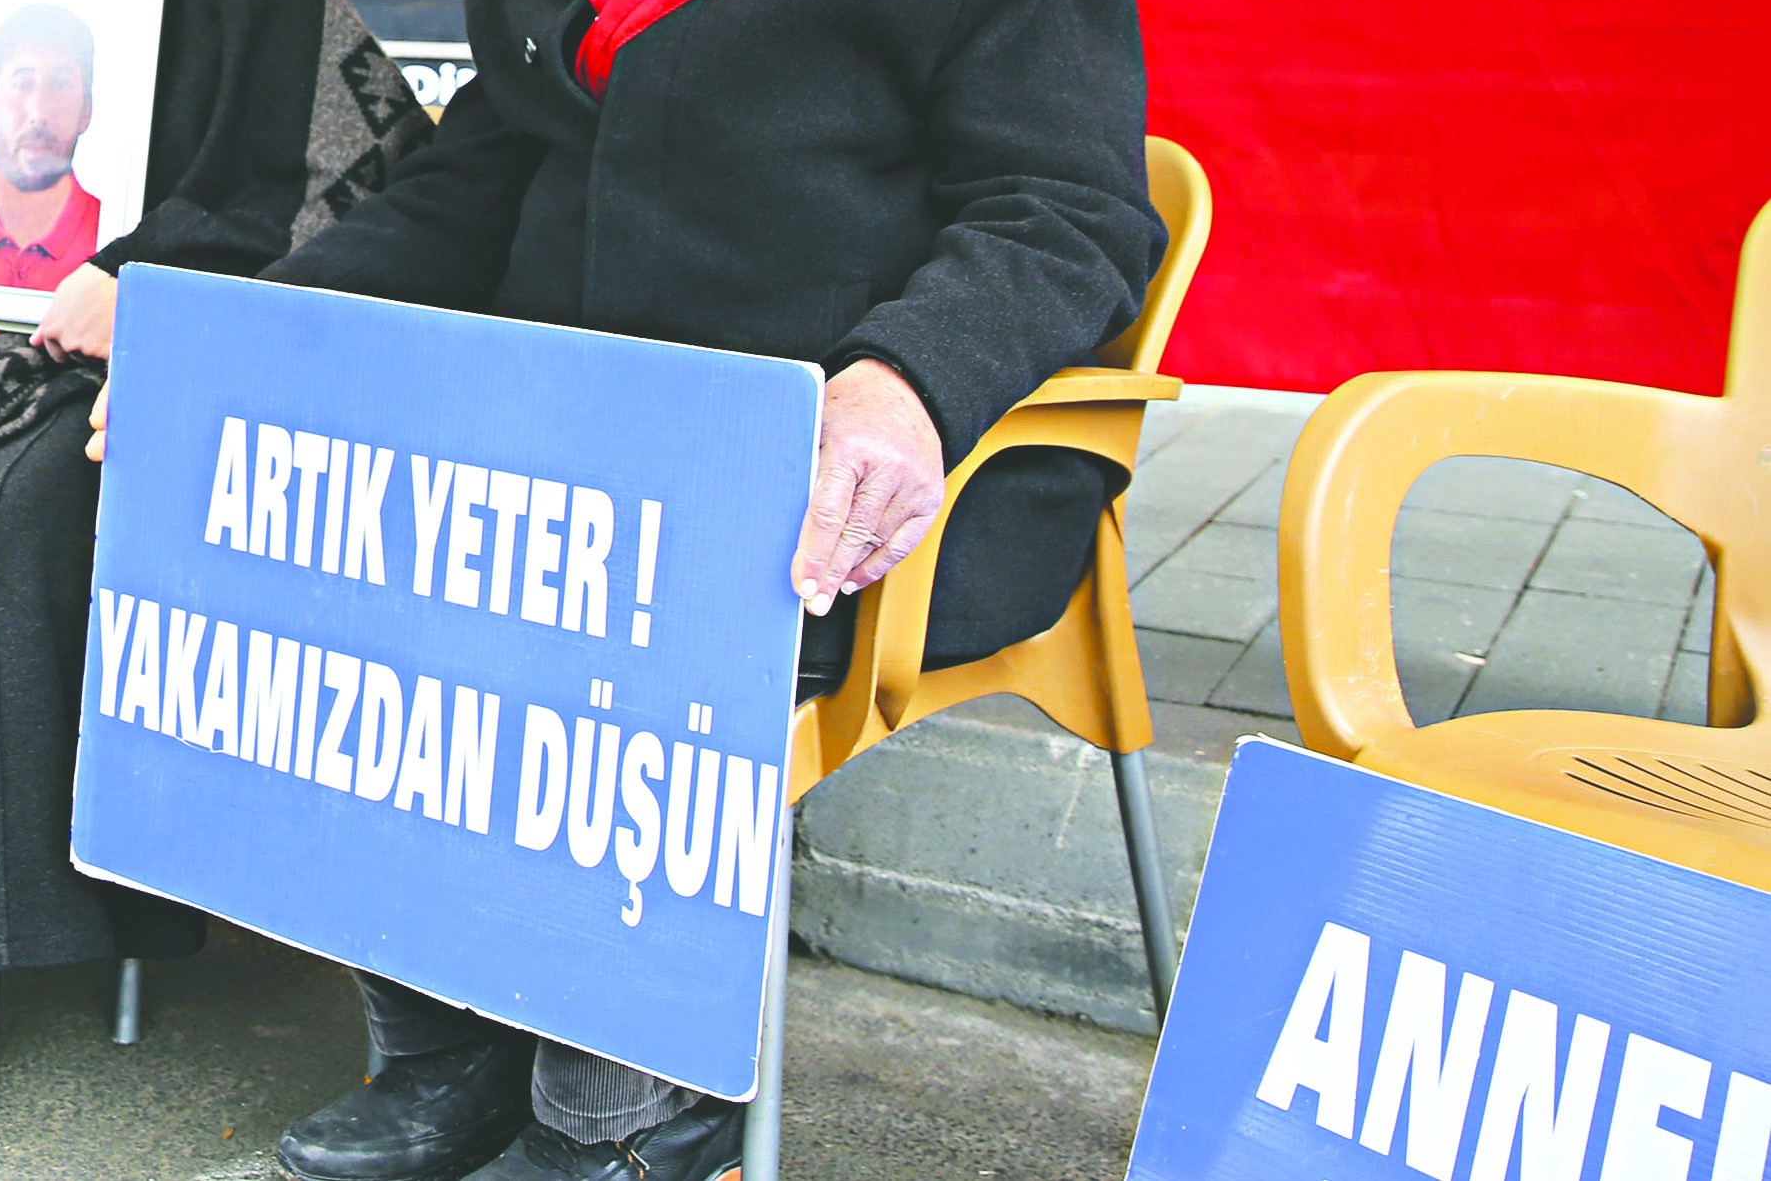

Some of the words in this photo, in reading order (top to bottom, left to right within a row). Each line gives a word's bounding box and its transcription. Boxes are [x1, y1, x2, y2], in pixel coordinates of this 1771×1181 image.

[204, 416, 396, 587] ARTIK
[409, 454, 614, 638] YETER
[97, 588, 500, 835] YAKAMIZDAN
[515, 679, 778, 927] DÜŞÜN
